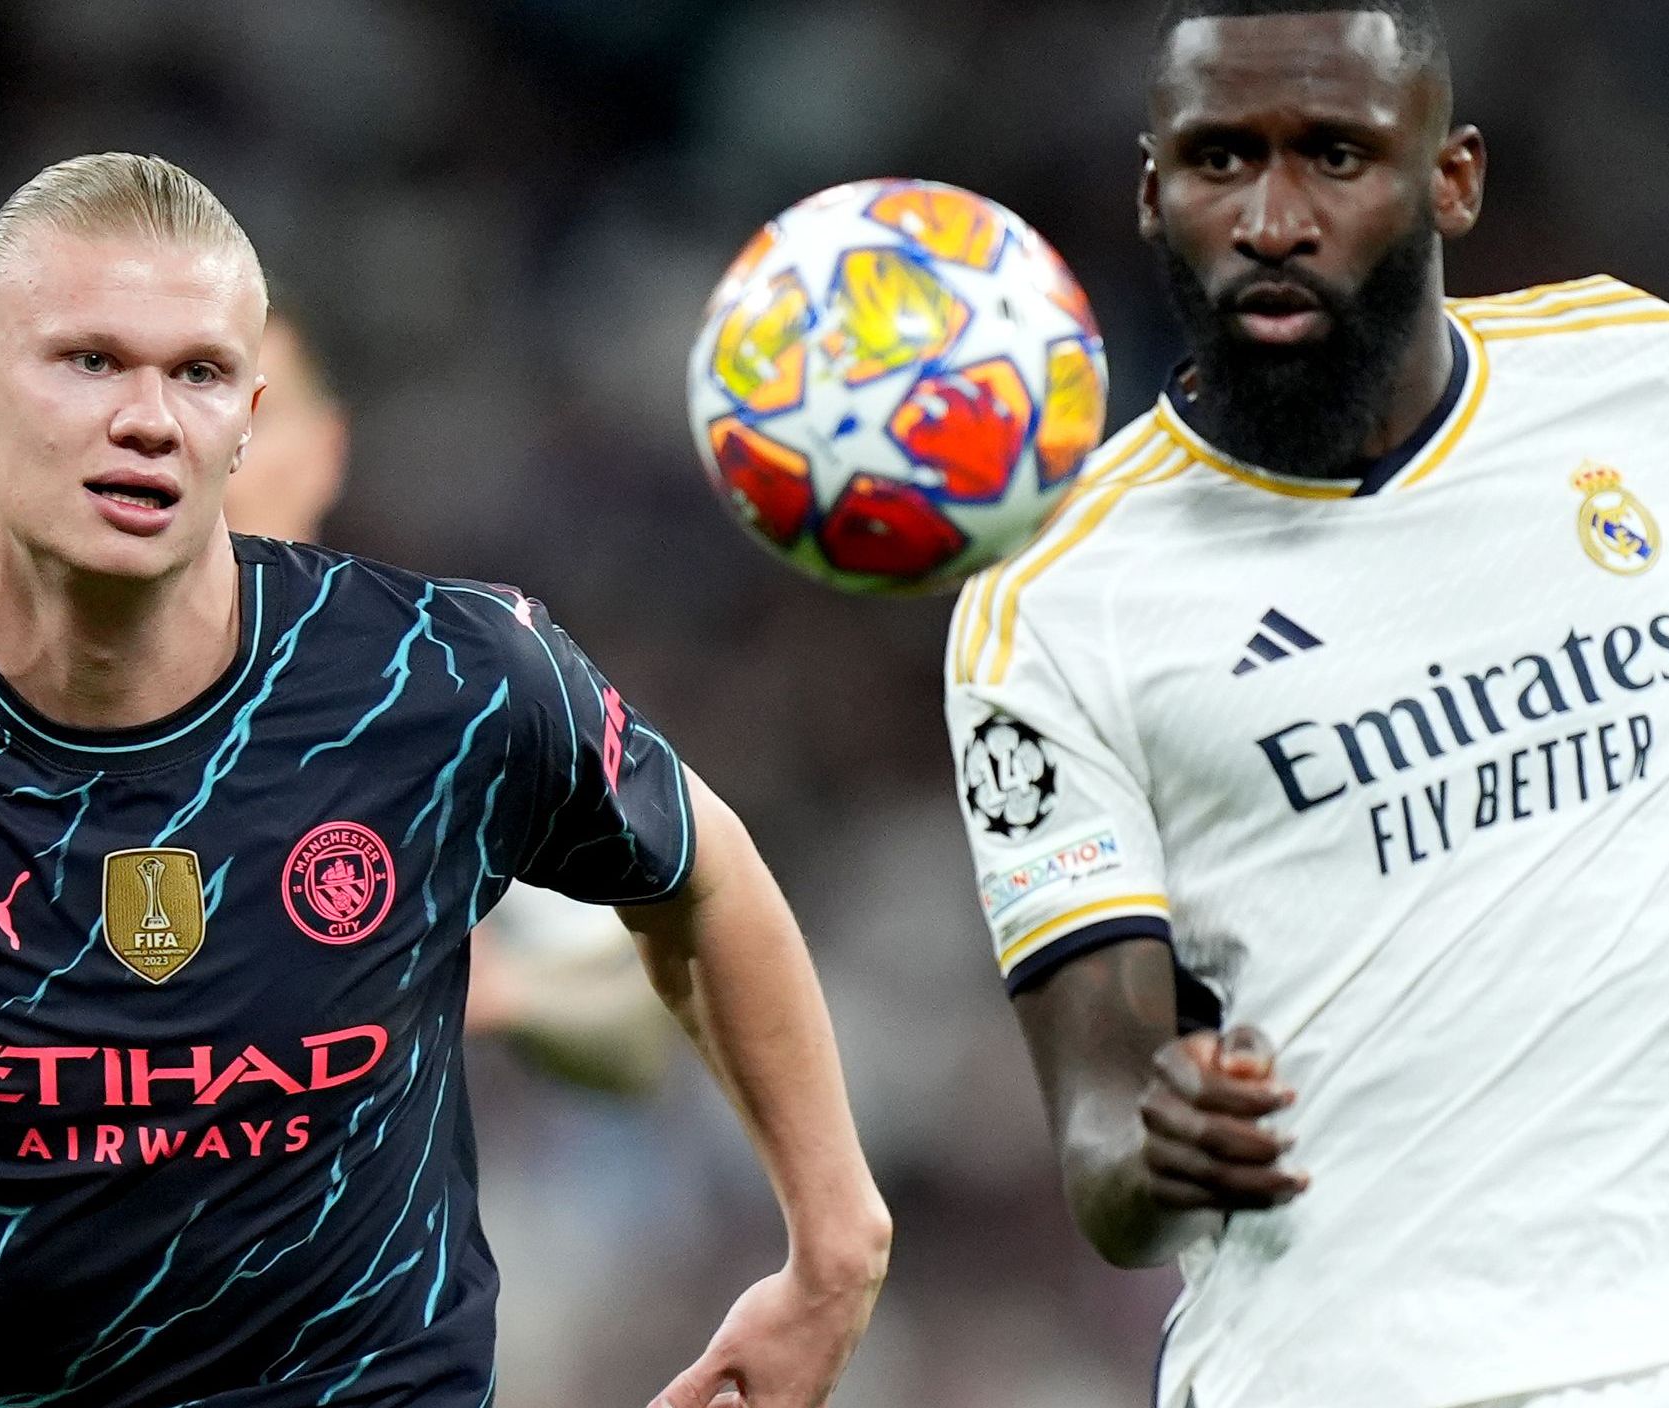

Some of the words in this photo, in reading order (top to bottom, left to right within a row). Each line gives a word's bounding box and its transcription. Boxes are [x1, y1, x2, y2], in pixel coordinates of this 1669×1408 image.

[1370, 780, 1452, 876] FLY
[1474, 714, 1653, 829] BETTER
[293, 831, 381, 874] MANCHESTER
[134, 932, 179, 948] FIFA
[328, 920, 361, 936] CITY
[143, 956, 169, 966] 2023
[17, 1115, 311, 1165] AIRWAYS
